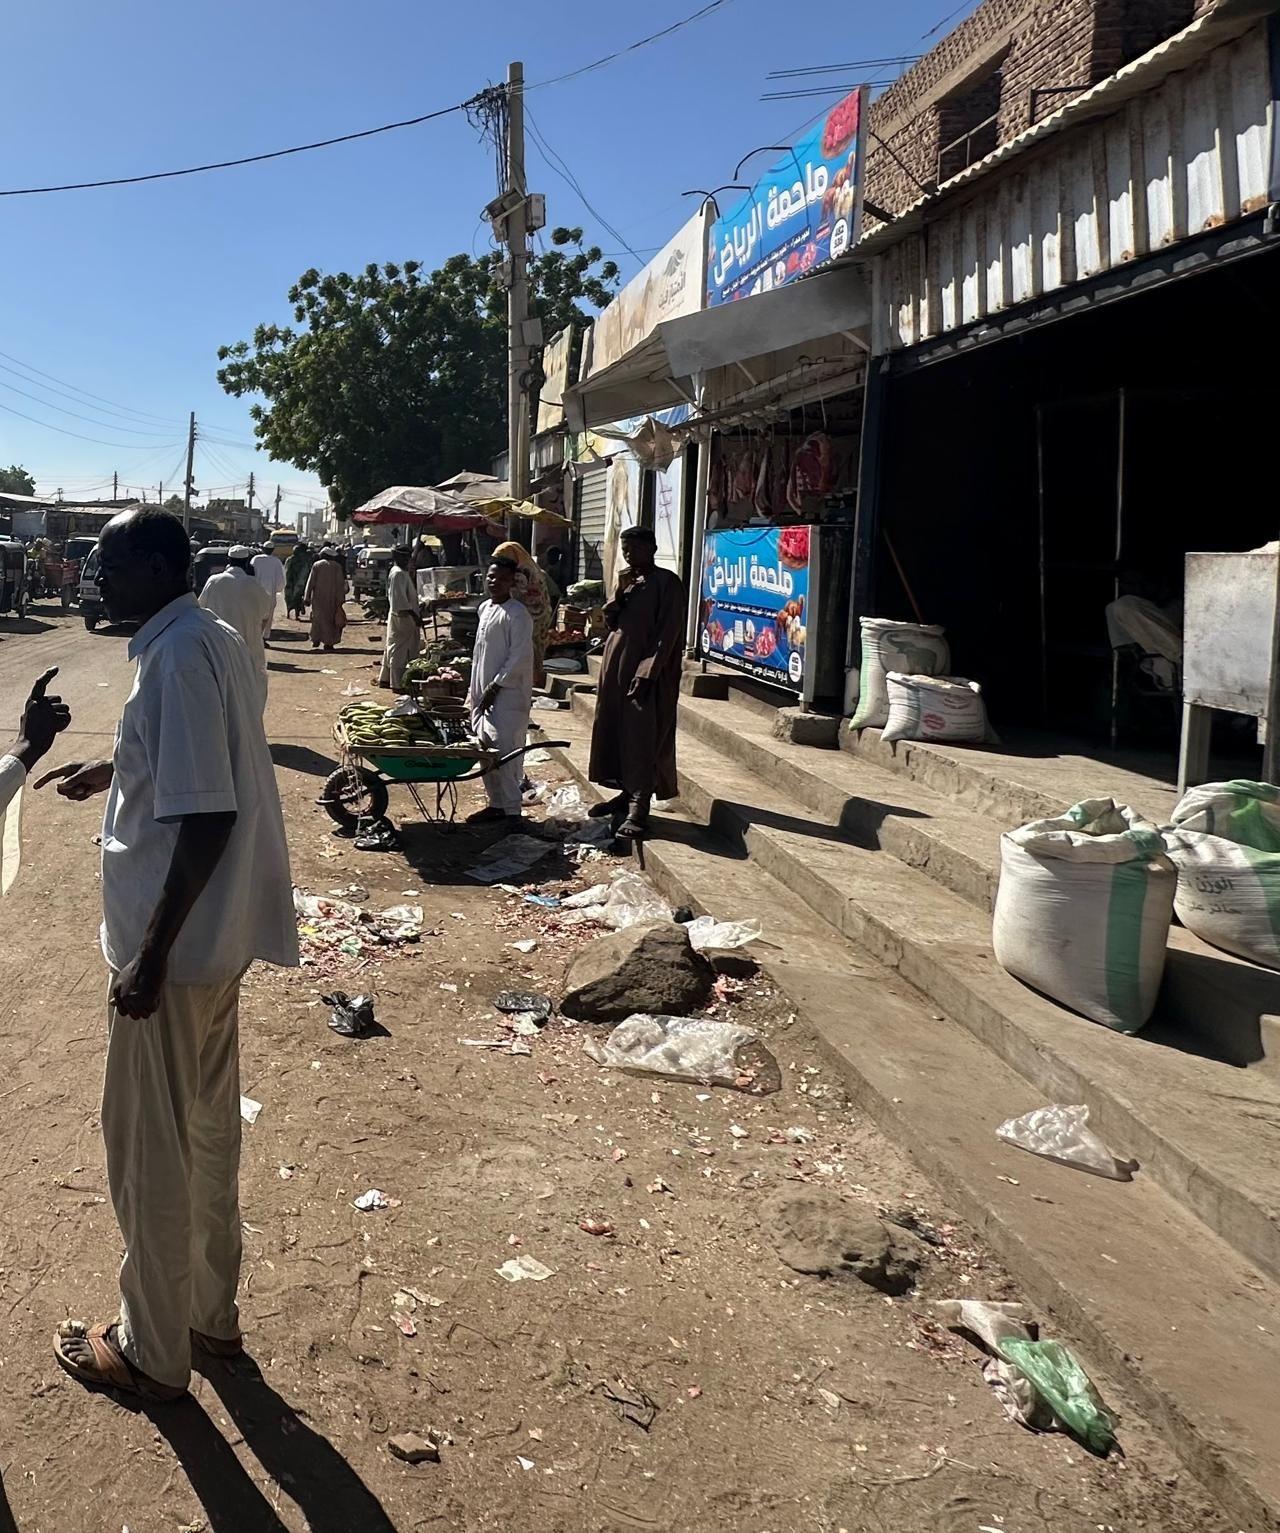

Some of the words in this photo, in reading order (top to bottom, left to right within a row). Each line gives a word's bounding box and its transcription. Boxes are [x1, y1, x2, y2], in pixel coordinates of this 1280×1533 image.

[766, 161, 829, 231] ملحمة
[713, 201, 763, 287] الرياض
[708, 556, 747, 596] الرياض
[749, 554, 794, 597] ملحمة
